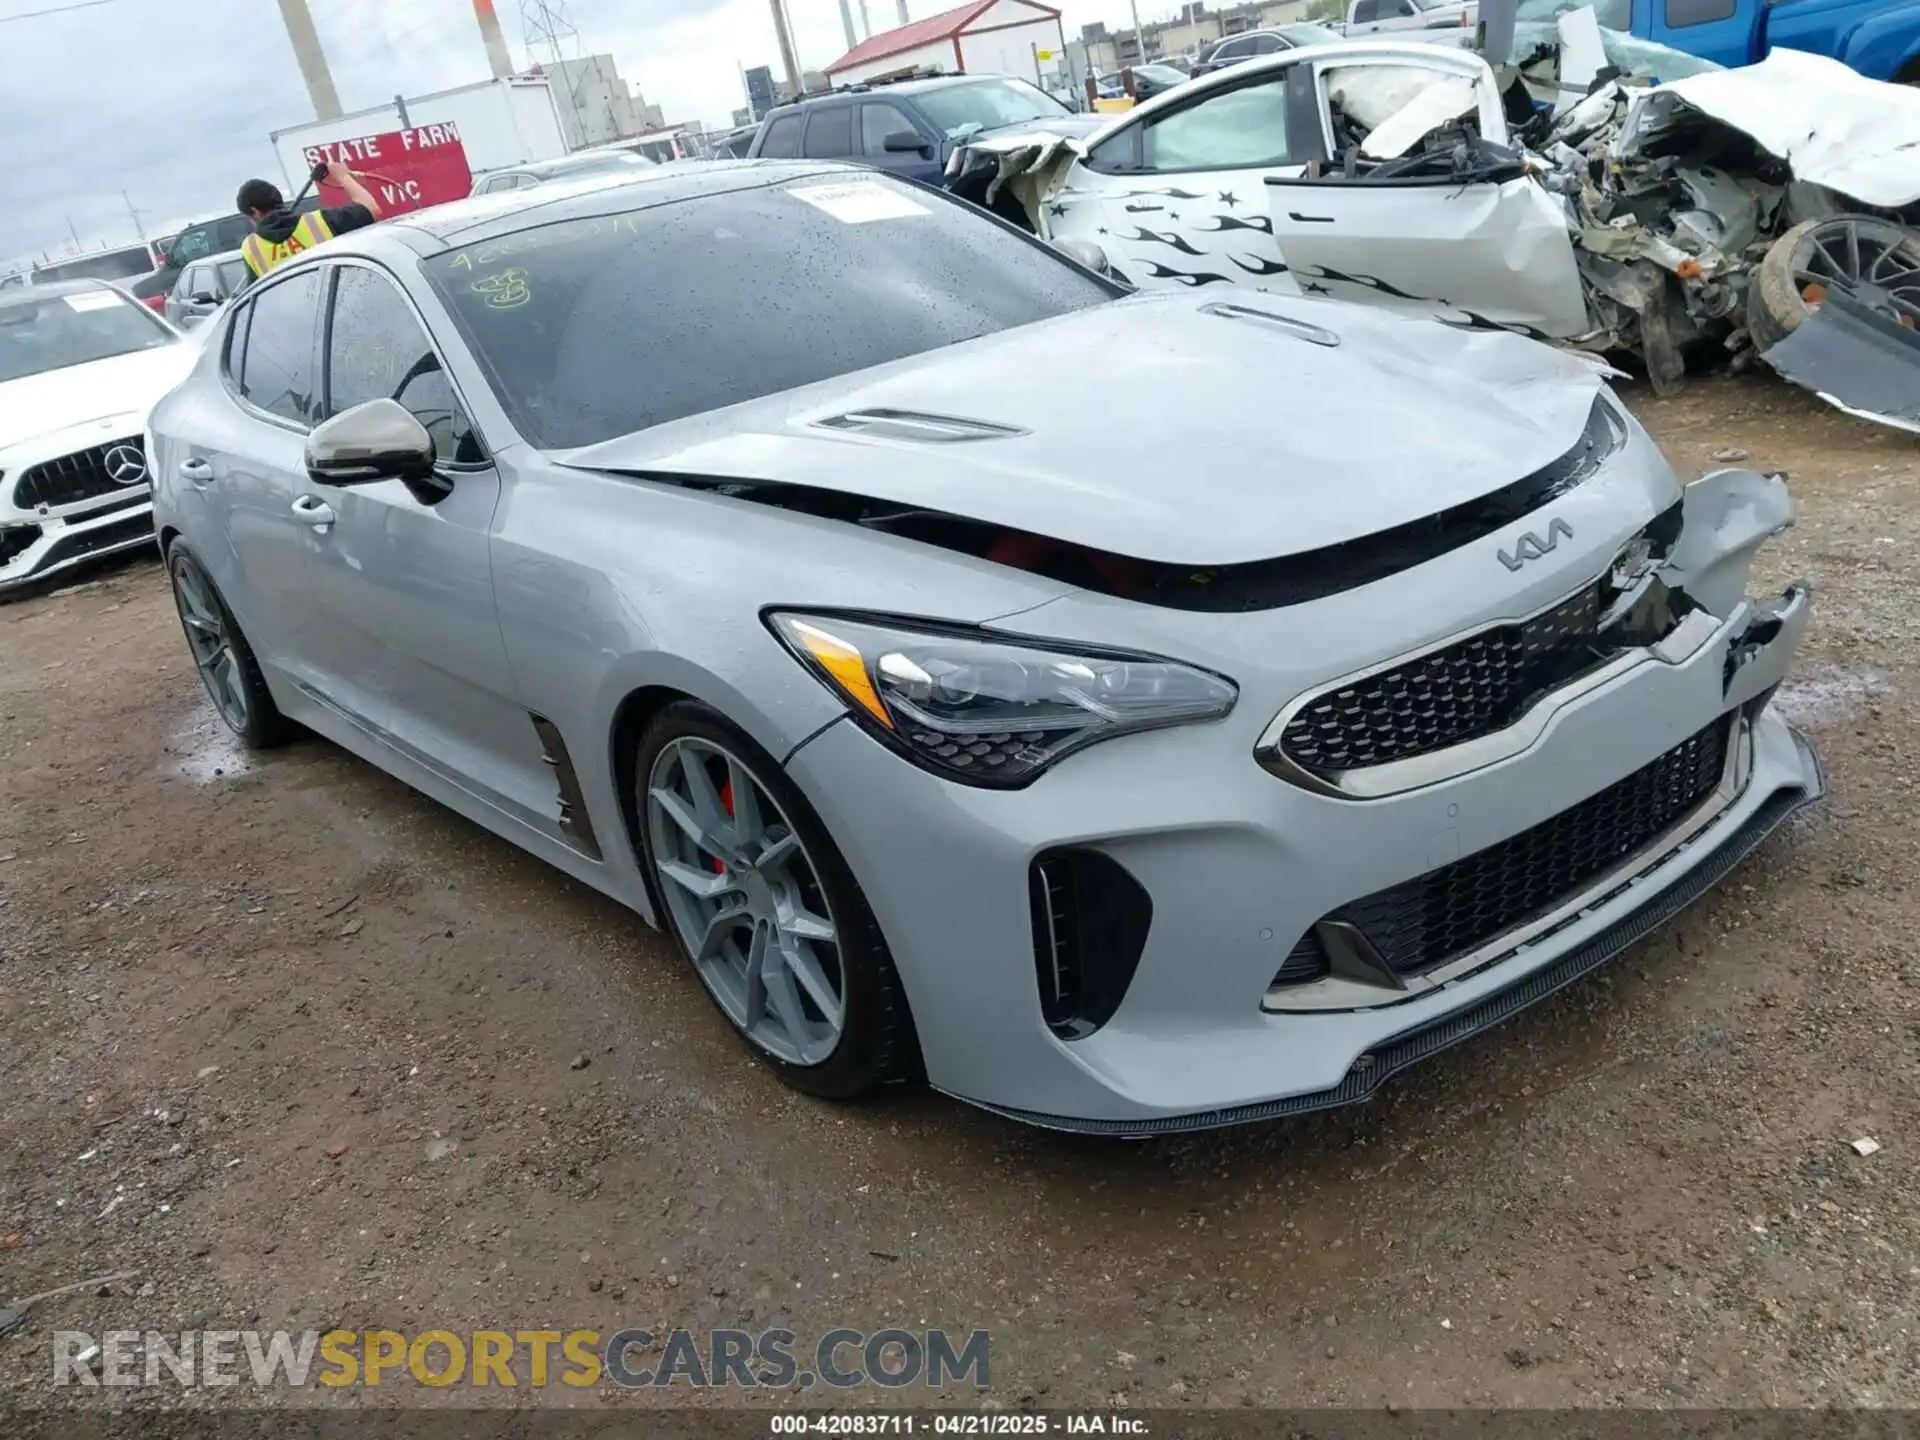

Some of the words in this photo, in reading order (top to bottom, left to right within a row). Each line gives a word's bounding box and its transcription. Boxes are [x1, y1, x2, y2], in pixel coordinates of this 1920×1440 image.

[305, 137, 381, 168] STATE
[401, 122, 460, 151] FARM
[380, 180, 421, 205] VIC
